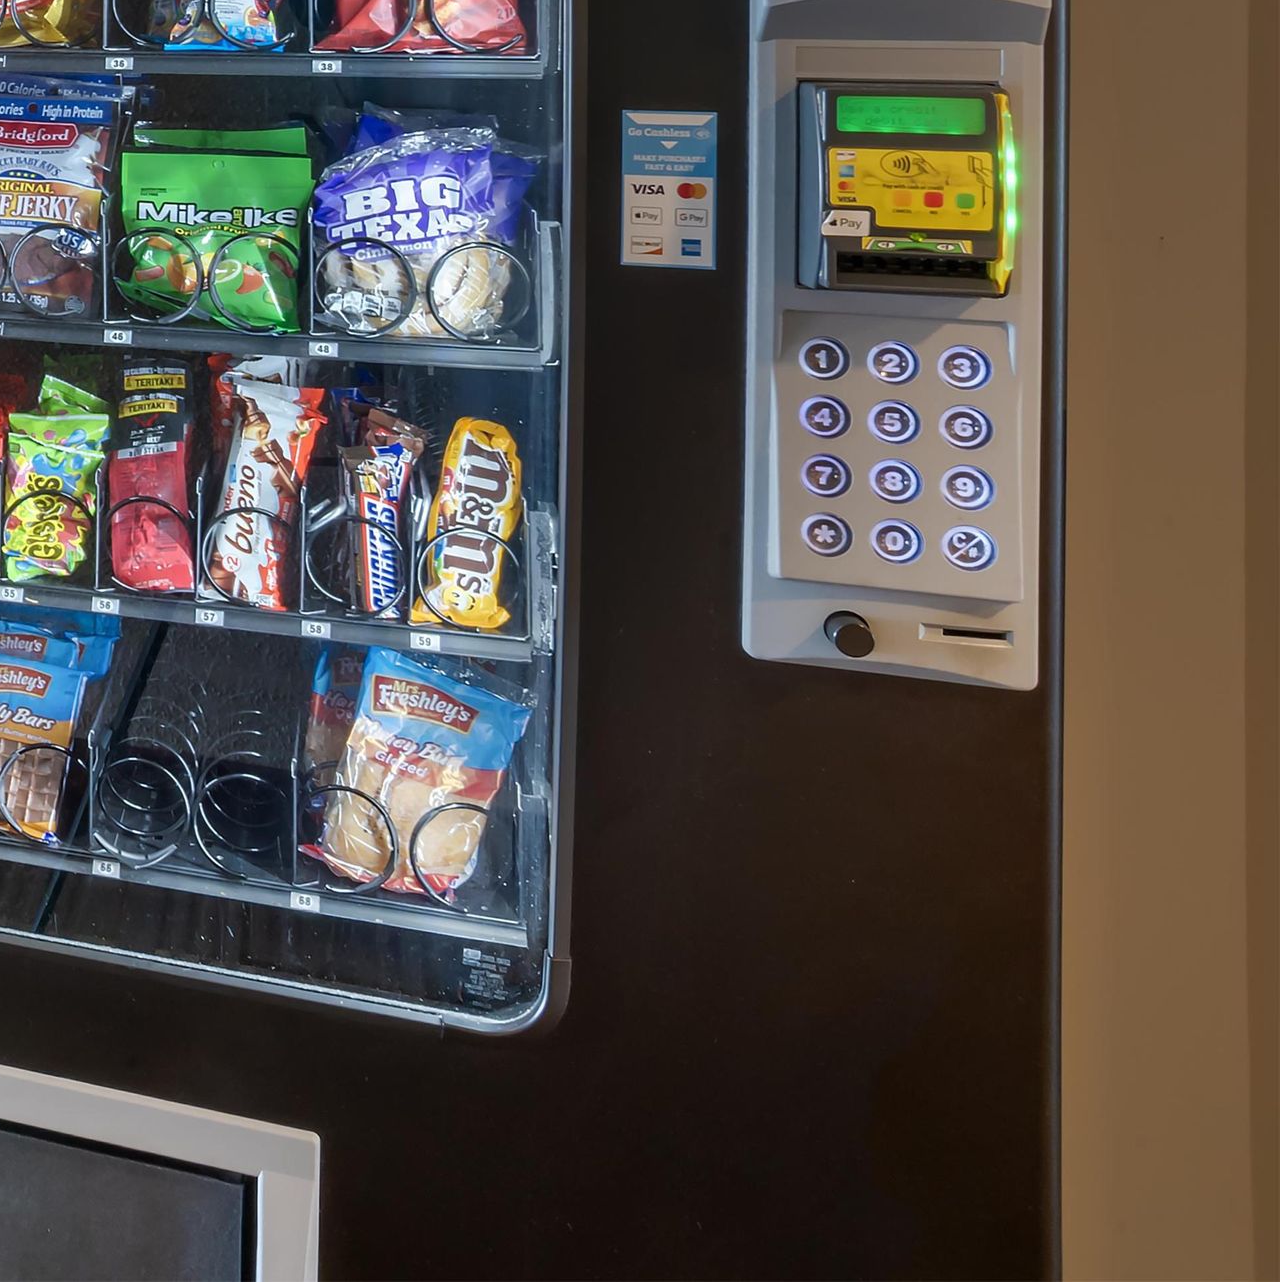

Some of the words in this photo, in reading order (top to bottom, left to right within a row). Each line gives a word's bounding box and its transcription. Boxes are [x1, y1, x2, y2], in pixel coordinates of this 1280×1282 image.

[321, 62, 333, 71] 38
[8, 82, 47, 96] Calories
[42, 105, 62, 120] High
[63, 107, 71, 117] in
[72, 107, 104, 118] Protein
[628, 128, 642, 136] Go
[644, 128, 690, 137] Cashless
[631, 183, 665, 195] VISA
[344, 176, 463, 219] BIG
[12, 194, 78, 222] JERKY
[138, 202, 233, 225] Mike
[244, 208, 297, 227] Ike
[642, 212, 659, 221] Pay
[332, 208, 476, 248] TEXAS
[840, 218, 863, 230] Pay
[354, 239, 434, 261] Cinnamon
[316, 344, 331, 355] 48
[135, 379, 173, 387] TERIYAKI
[129, 403, 165, 412] TERIYAKI
[225, 464, 257, 555] bueno
[392, 681, 419, 694] Mrs.
[378, 684, 471, 724] Freshley's
[12, 708, 56, 731] Bars
[375, 750, 428, 777] Glazed
[298, 896, 311, 906] 68
